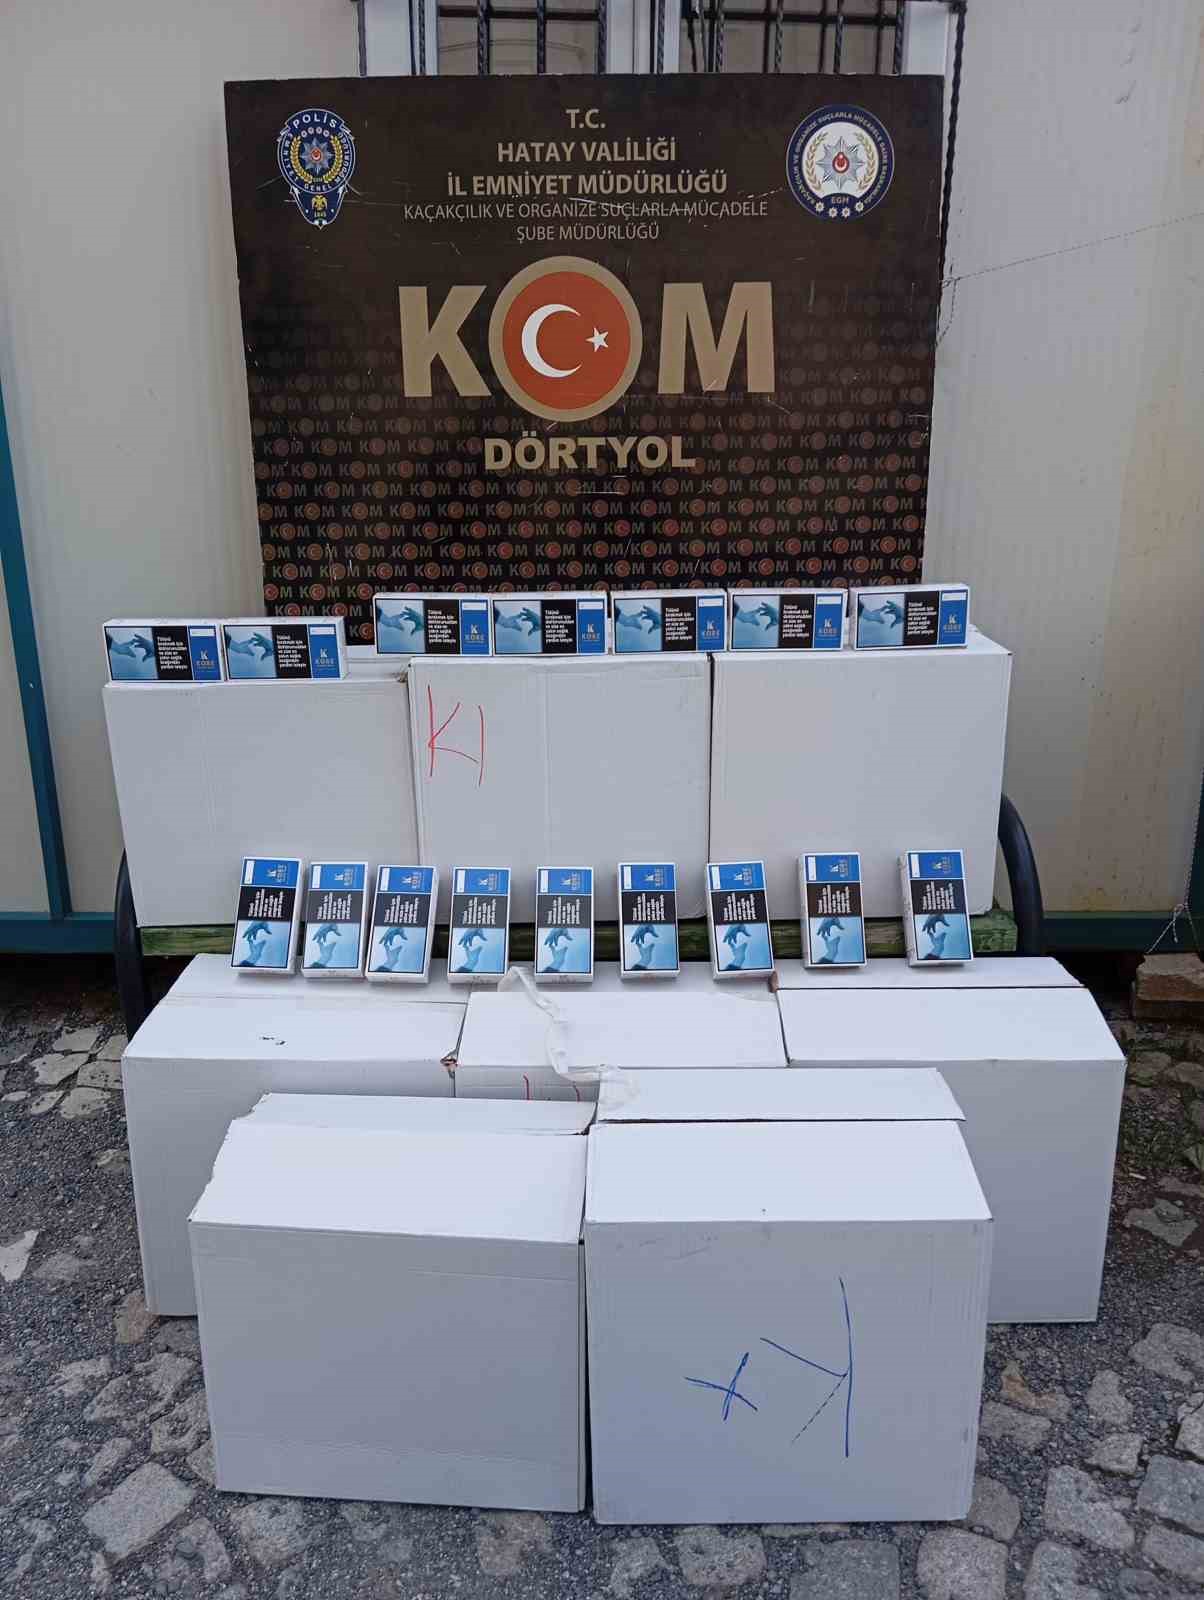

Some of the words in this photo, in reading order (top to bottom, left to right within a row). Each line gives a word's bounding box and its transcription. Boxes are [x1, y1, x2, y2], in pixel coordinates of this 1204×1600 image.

[566, 108, 606, 129] T.C.
[497, 141, 576, 163] HATAY
[582, 136, 676, 162] VALİLİĞİ
[447, 171, 468, 196] İL
[473, 170, 572, 195] EMNİYET
[577, 169, 728, 195] MÜDÜRLÜĞÜ
[404, 203, 494, 223] KAÇAKÇILIK
[495, 203, 515, 218] VE
[600, 201, 682, 220] SUÇLARLA
[683, 200, 768, 218] MÜCADELE
[516, 225, 555, 244] ŞUBE
[559, 222, 660, 241] MÜDÜRLÜĞÜ
[399, 255, 775, 423] KOM
[484, 431, 697, 471] DÖRTYOL
